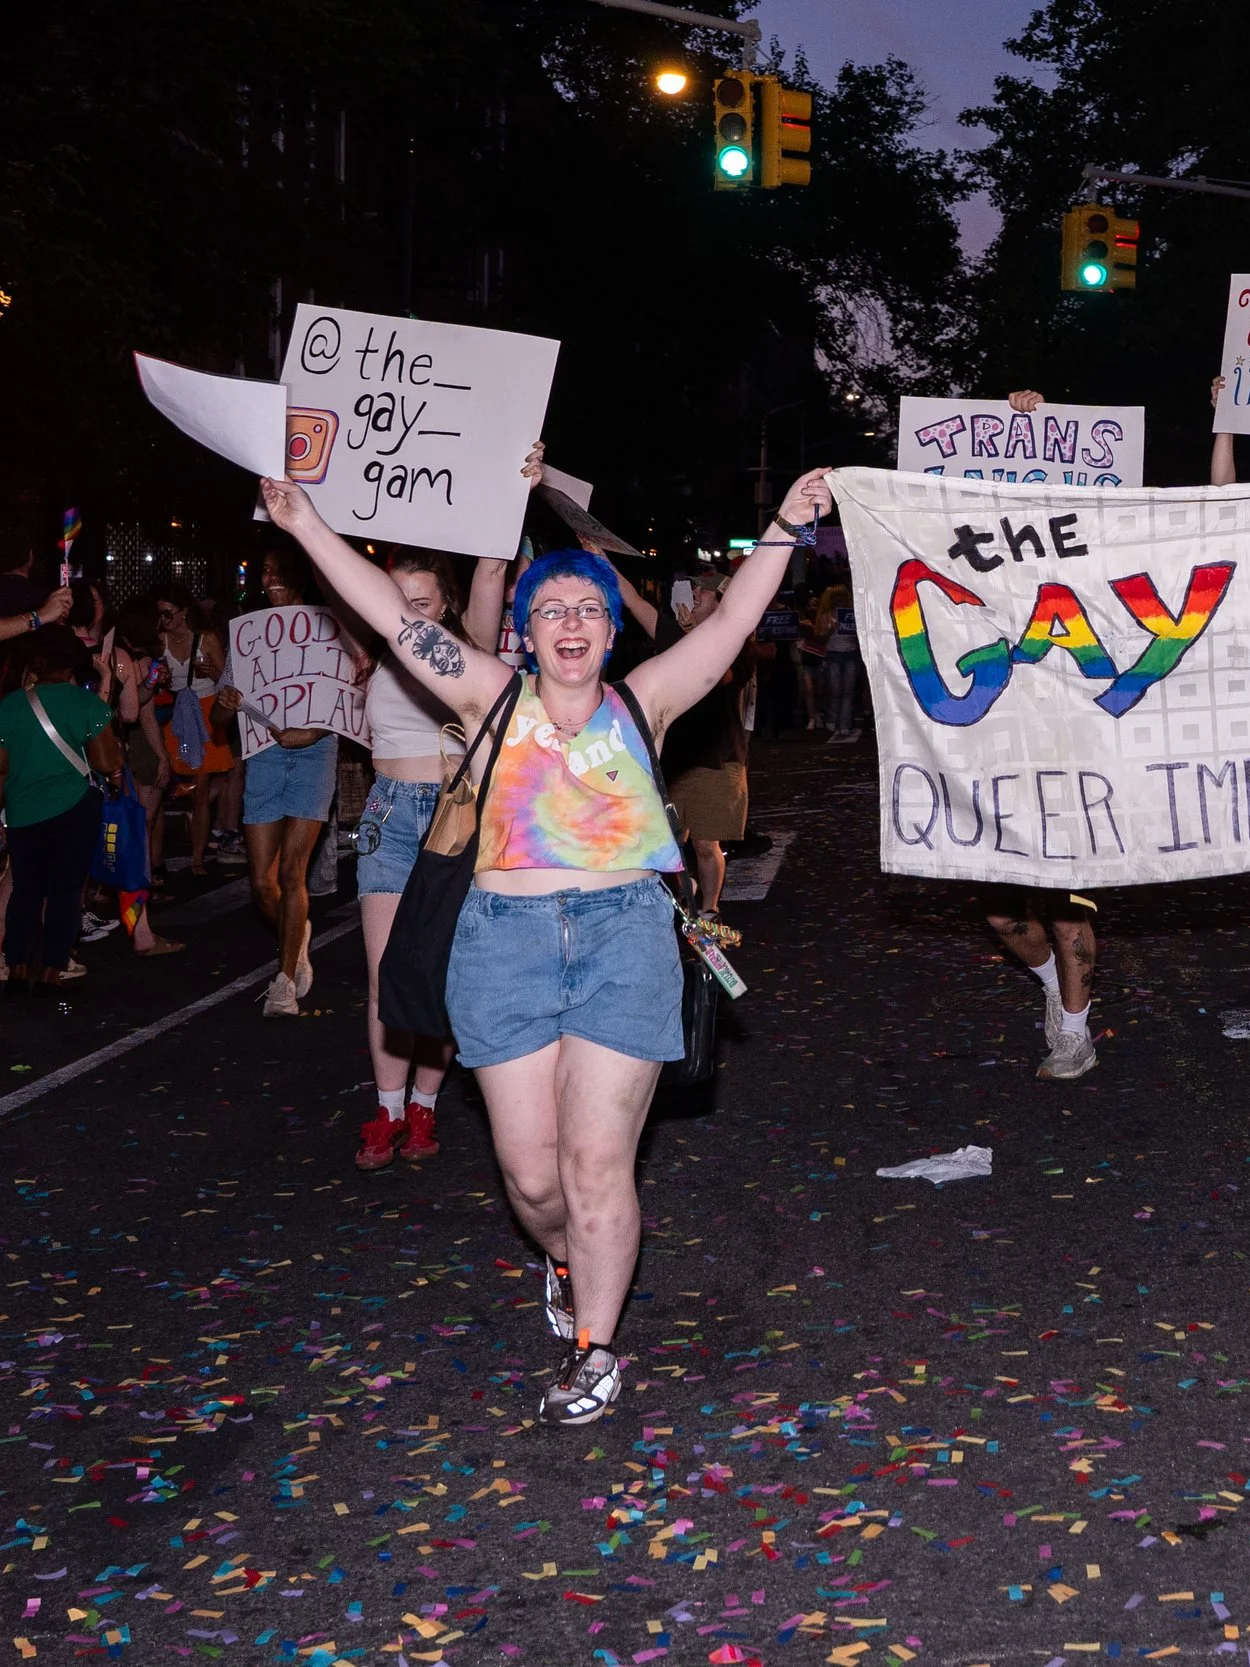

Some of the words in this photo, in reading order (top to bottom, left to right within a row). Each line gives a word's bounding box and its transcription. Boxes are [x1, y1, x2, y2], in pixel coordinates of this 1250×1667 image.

[914, 413, 1123, 469] TRANS
[352, 460, 452, 520] gam
[236, 611, 341, 657] GOOD
[889, 557, 1237, 727] GAY
[243, 681, 373, 755] APPLAU
[889, 763, 1126, 859] QUEER
